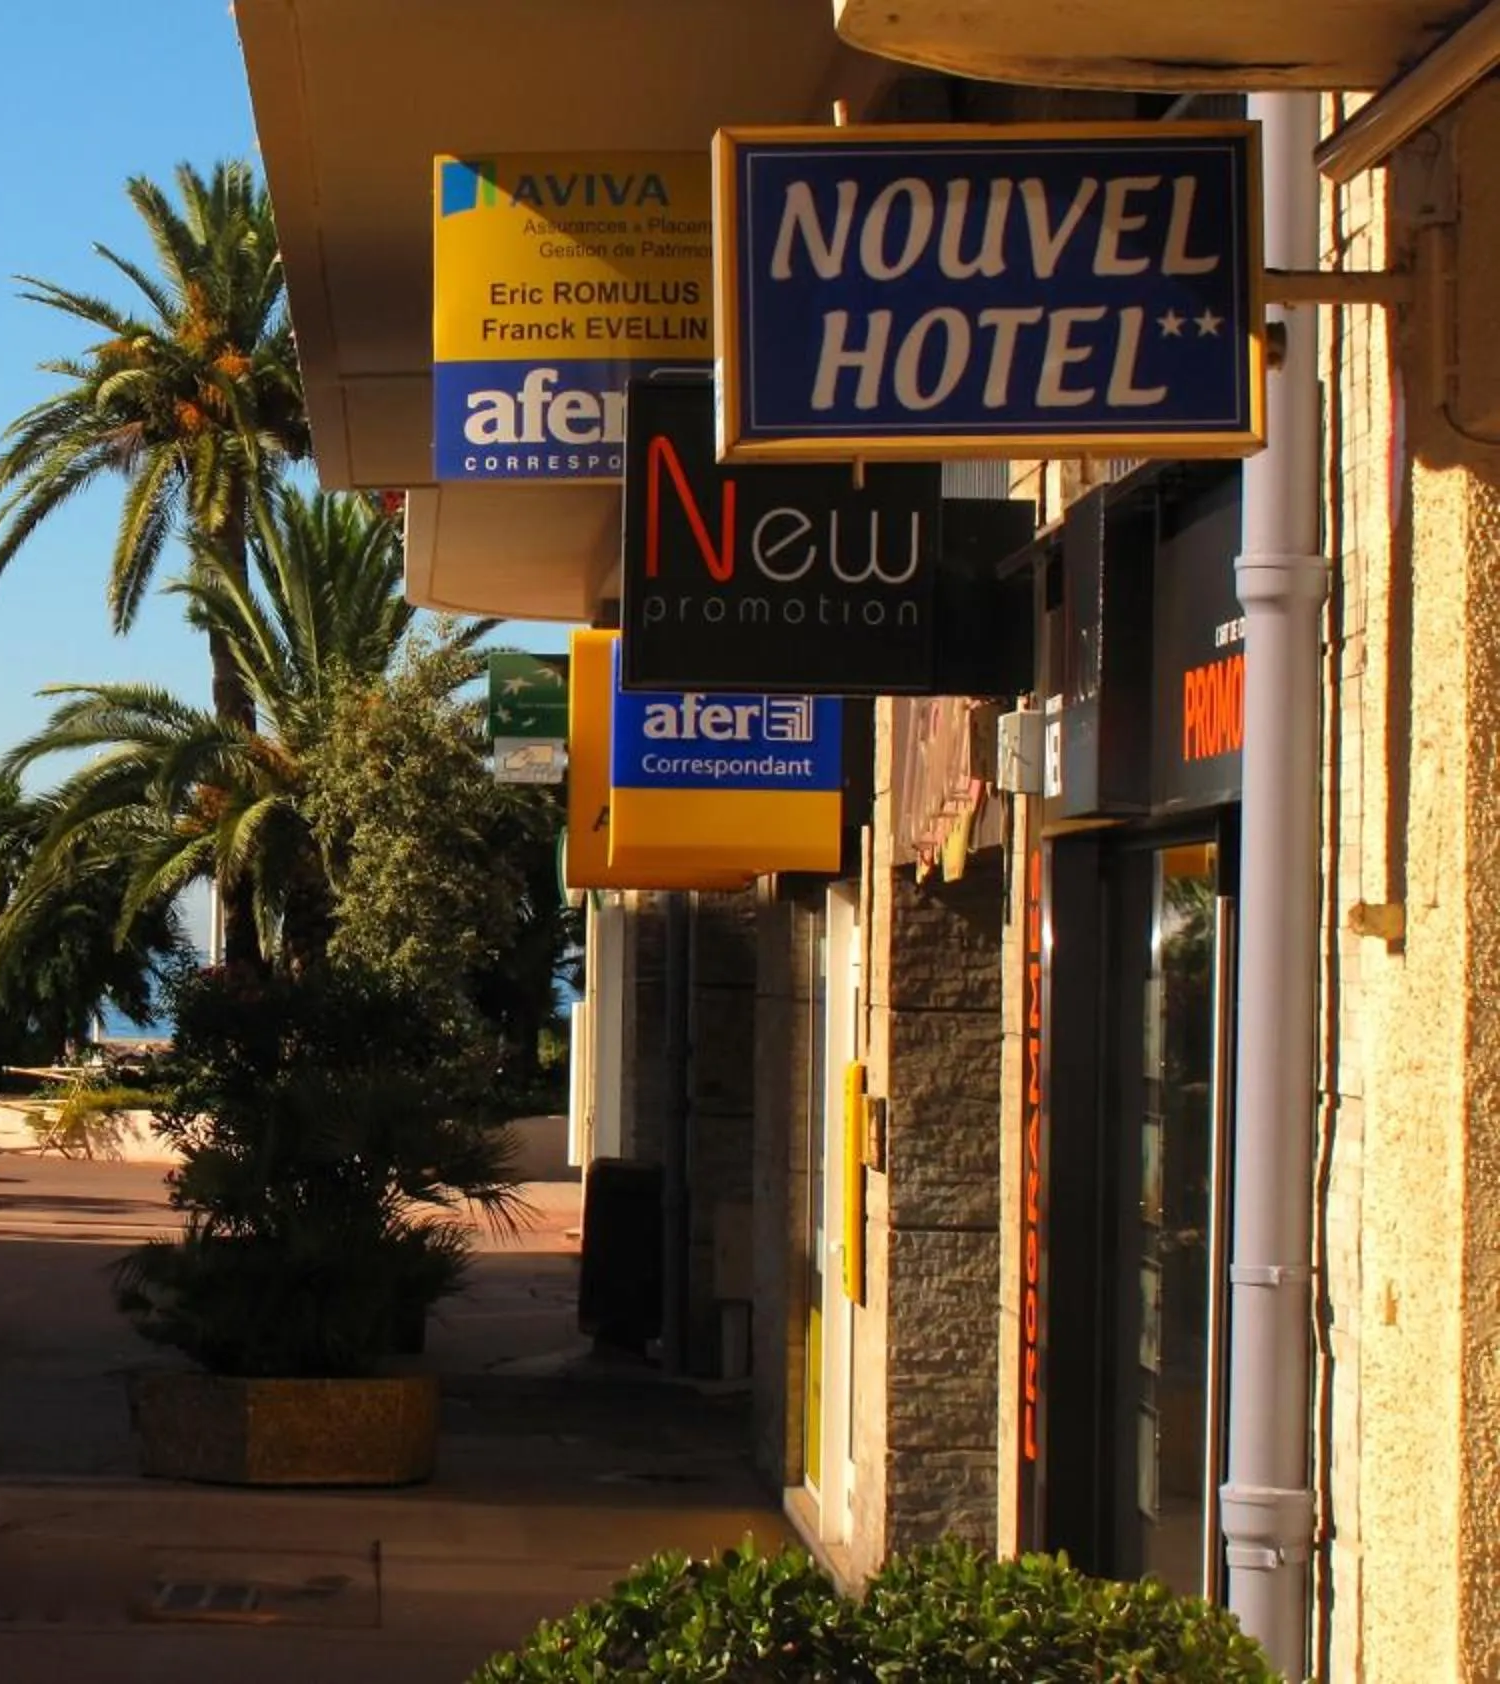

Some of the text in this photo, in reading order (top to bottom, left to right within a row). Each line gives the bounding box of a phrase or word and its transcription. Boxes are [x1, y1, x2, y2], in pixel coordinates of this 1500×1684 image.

[512, 174, 669, 206] AVIVA
[524, 218, 627, 236] Assurances
[770, 175, 1221, 280] NOUVEL
[539, 240, 608, 258] Gestion
[612, 240, 636, 258] de
[490, 281, 701, 306] Eric ROMULUS
[482, 317, 709, 341] Franck EVELLIN
[810, 305, 1169, 412] HOTEL
[464, 368, 627, 445] afer
[464, 455, 623, 471] CORRESPO
[646, 436, 919, 584] New
[644, 594, 918, 627] promotion
[643, 693, 761, 741] afer
[1184, 655, 1244, 761] PROMO
[642, 753, 812, 779] Correspondant
[1025, 849, 1041, 1460] PROGRAMMES
